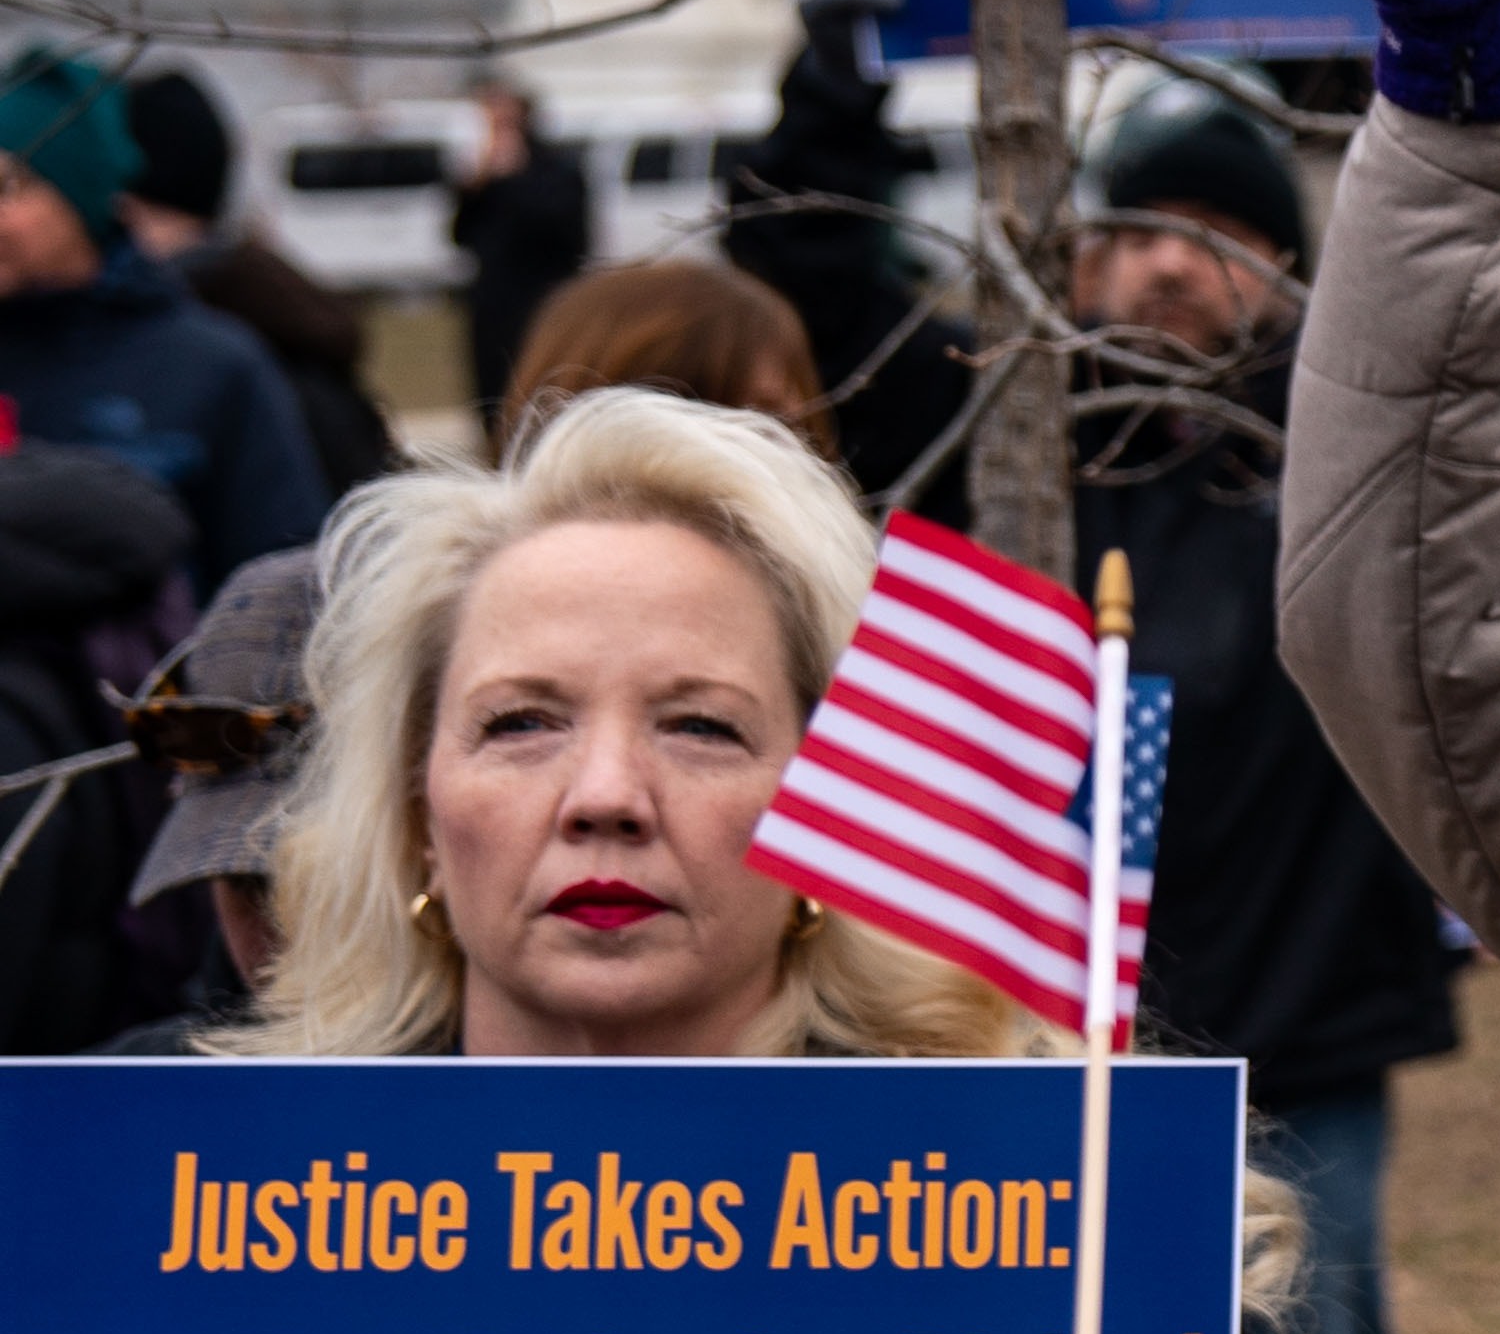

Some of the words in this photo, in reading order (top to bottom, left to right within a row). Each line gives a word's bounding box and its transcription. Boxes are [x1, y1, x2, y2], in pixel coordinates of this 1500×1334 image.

[161, 1152, 467, 1271] Justice
[498, 1153, 743, 1270] Takes
[771, 1152, 1071, 1269] Action:
